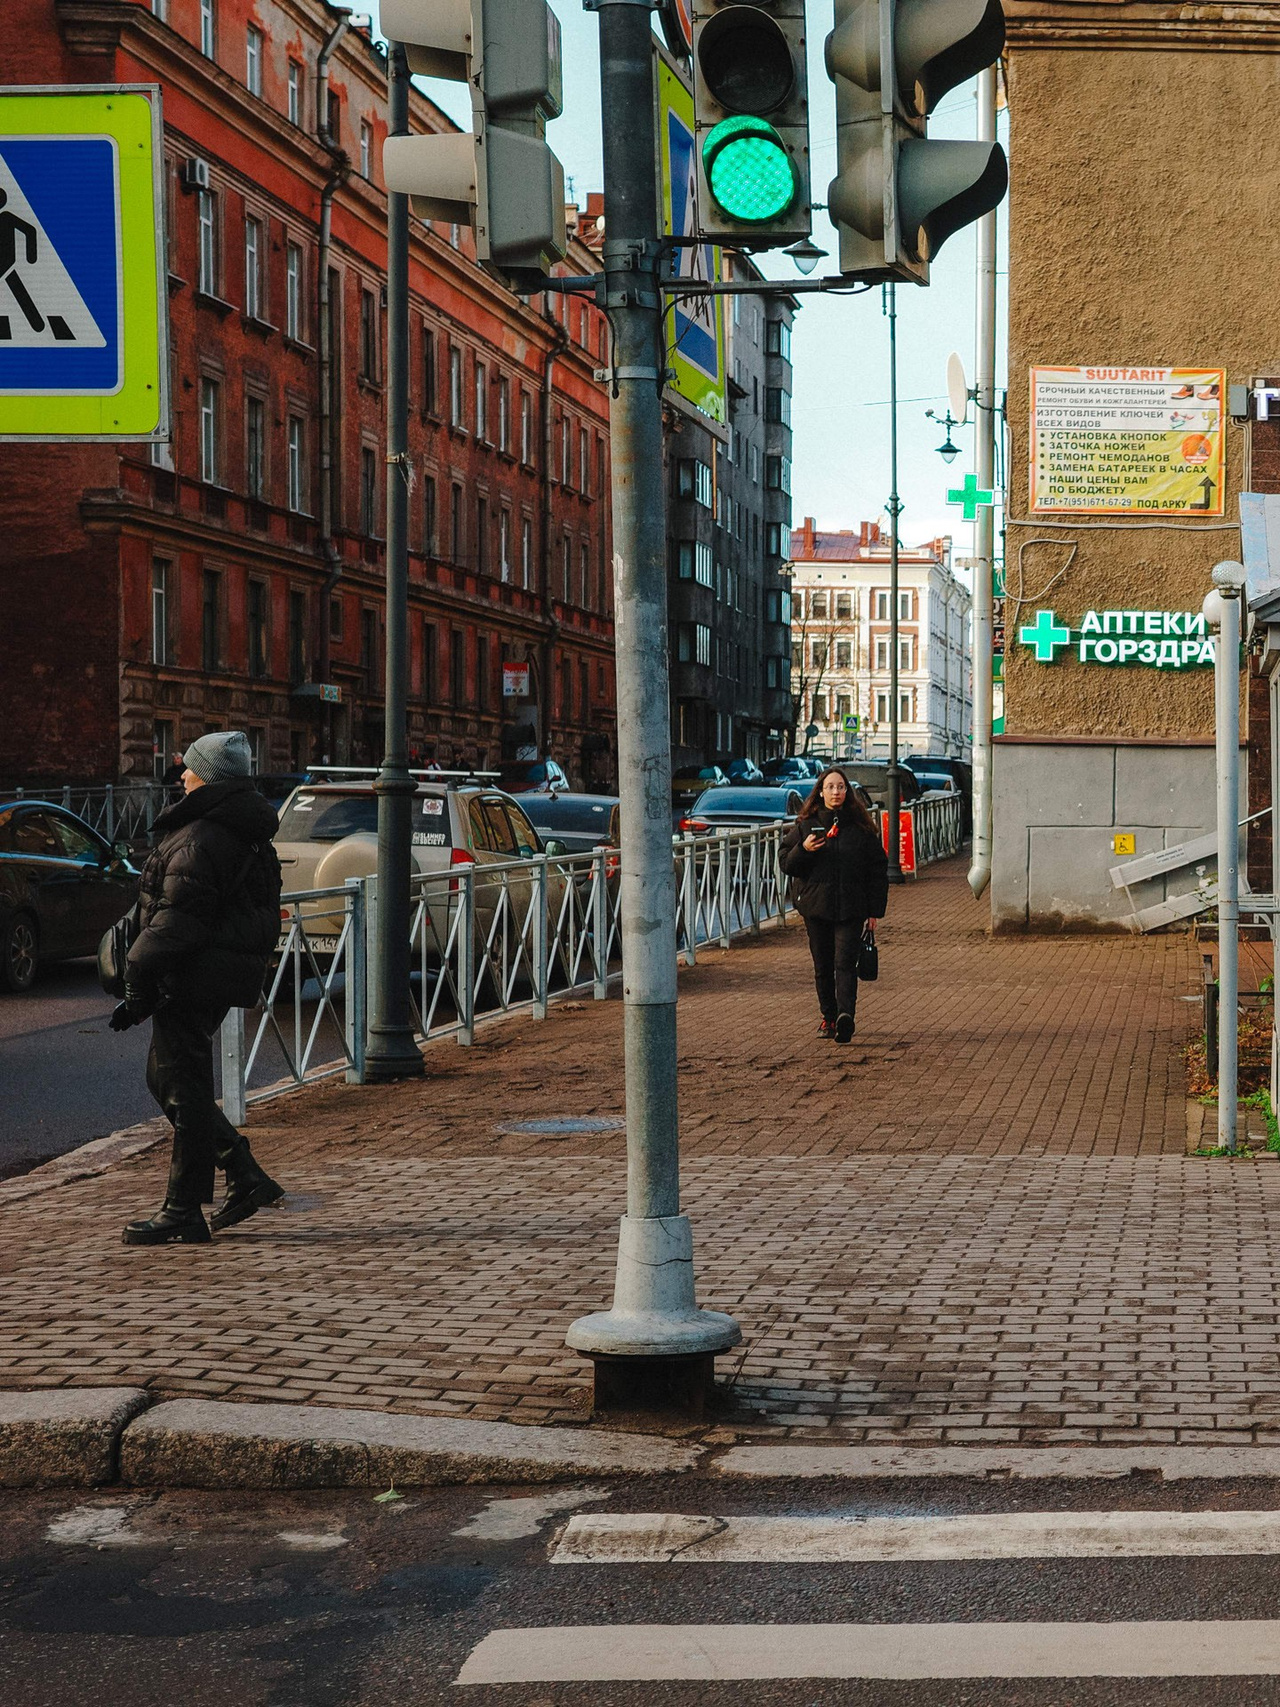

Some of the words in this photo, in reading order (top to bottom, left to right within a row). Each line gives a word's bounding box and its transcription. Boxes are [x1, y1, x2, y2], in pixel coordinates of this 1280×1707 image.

[1086, 369, 1167, 381] SUUTARIT
[1039, 386, 1086, 395] СРОЧНЫЙ
[1088, 387, 1165, 396] КАЧЕСТВЕННЫЙ
[1037, 409, 1117, 418] ИЗГОТОВЛЕНИЕ
[1120, 410, 1164, 419] КЛЮЧЕЙ
[1066, 420, 1101, 428] ВИДОВ
[1050, 432, 1117, 441] УСТАНОВКА
[1120, 433, 1167, 442] КНОПОК
[1049, 442, 1101, 450] ЗАТОЧКА
[1104, 442, 1146, 451] НОЖЕЙ
[1049, 453, 1095, 461] РЕМОНТ
[1099, 453, 1170, 463] ЧЕМОДАНОВ
[1049, 464, 1095, 472] ЗАМЕНА
[1098, 464, 1156, 473] БАТАРЕЕК
[1159, 465, 1166, 473] В
[1170, 465, 1207, 474] ЧАСАХ
[1049, 475, 1083, 484] НАШИ
[1087, 476, 1120, 485] ЦЕНЫ
[1124, 476, 1148, 485] ВАМ
[1049, 485, 1066, 494] ПО
[1068, 486, 1126, 495] БЮДЖЕТУ
[1137, 499, 1159, 509] ПОД
[1161, 500, 1187, 509] АРКУ
[1080, 611, 1205, 635] АПТЕКИ
[1079, 639, 1216, 667] ГОРЗДРА
[293, 796, 315, 811] Z
